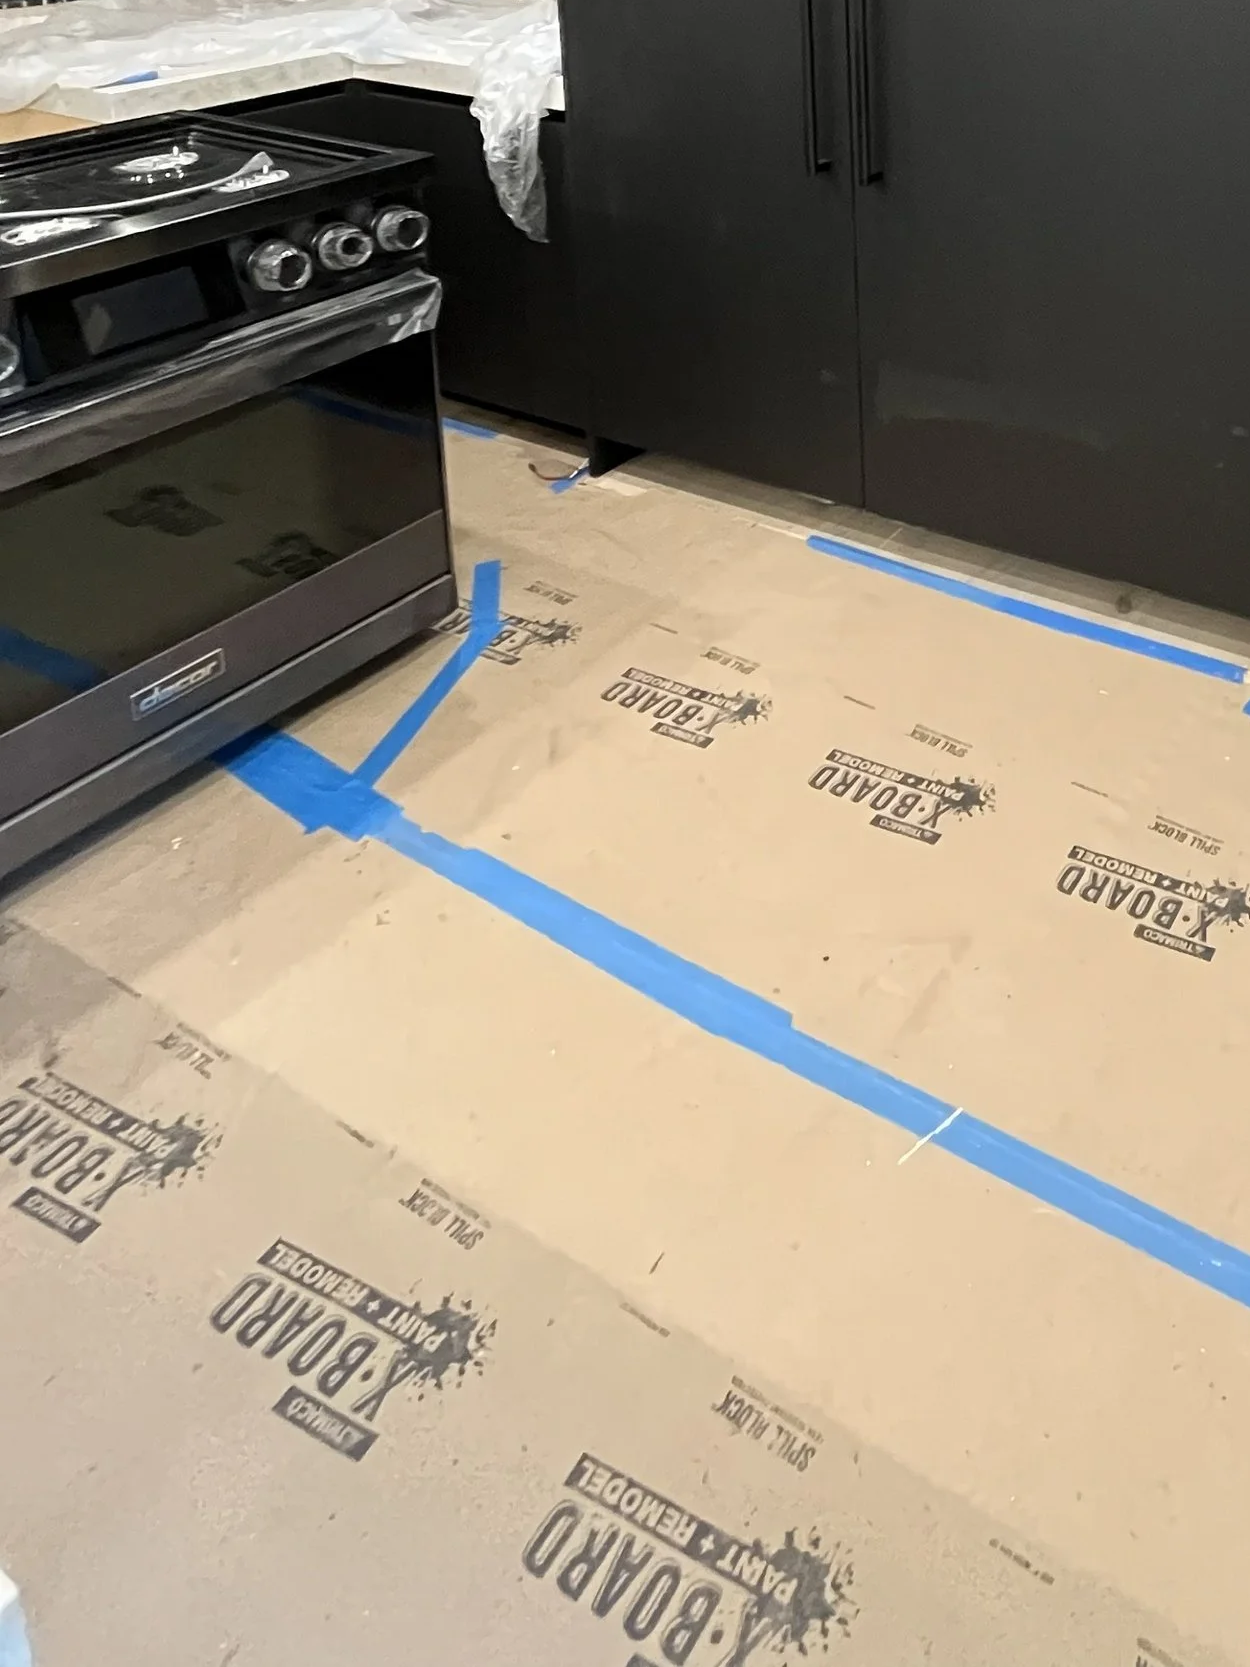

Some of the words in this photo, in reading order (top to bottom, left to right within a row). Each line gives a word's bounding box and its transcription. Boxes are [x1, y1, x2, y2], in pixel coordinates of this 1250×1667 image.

[139, 660, 218, 712] dacor
[833, 752, 904, 782] REMODEL
[920, 776, 965, 802] PAINT
[1151, 820, 1188, 844] BLOCK
[1189, 837, 1221, 857] SPILL
[1074, 848, 1158, 883] REMODEL
[1175, 882, 1229, 908] PAINT
[269, 1243, 371, 1307] REMODEL
[377, 1307, 448, 1353] PAINT
[713, 1390, 770, 1440] BLOCK
[768, 1424, 817, 1472] SPILL
[576, 1459, 699, 1541] REMODEL
[716, 1543, 798, 1605] PAINT
